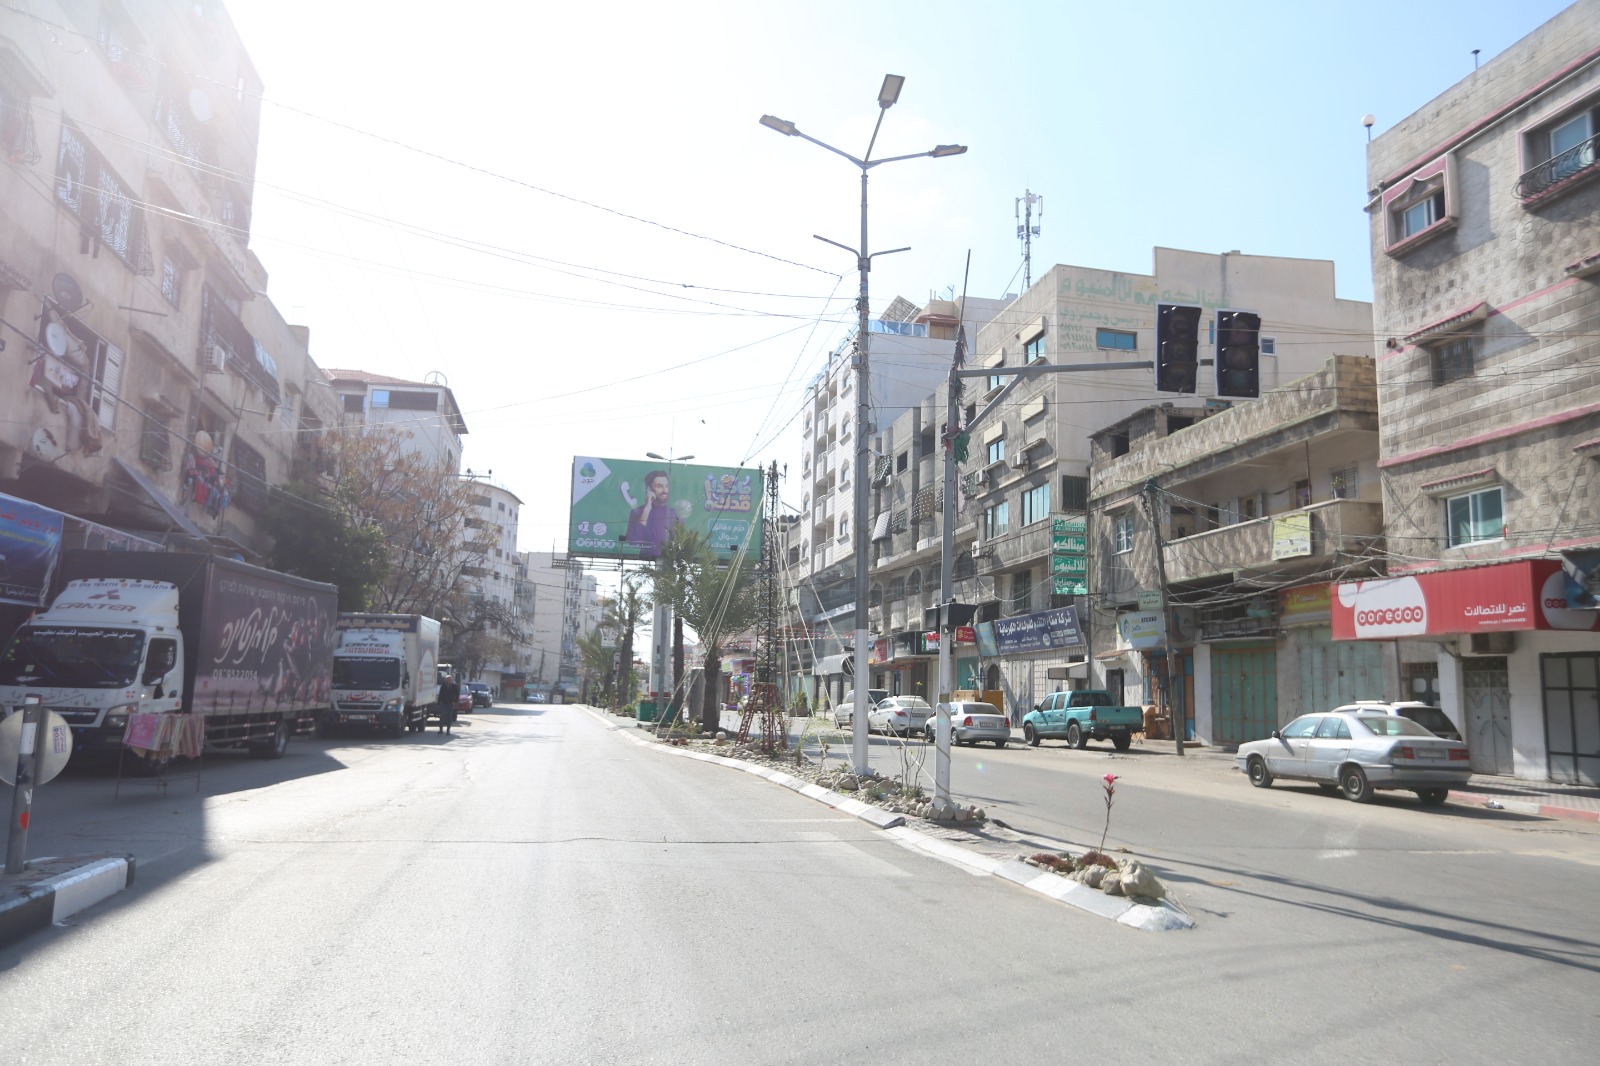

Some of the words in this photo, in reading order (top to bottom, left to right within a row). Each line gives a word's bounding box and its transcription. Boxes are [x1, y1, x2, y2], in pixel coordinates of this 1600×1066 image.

[56, 603, 137, 611] CANTER
[1464, 603, 1506, 616] للاتصالات
[1508, 603, 1526, 616] نصر
[1359, 607, 1422, 624] ooredoo
